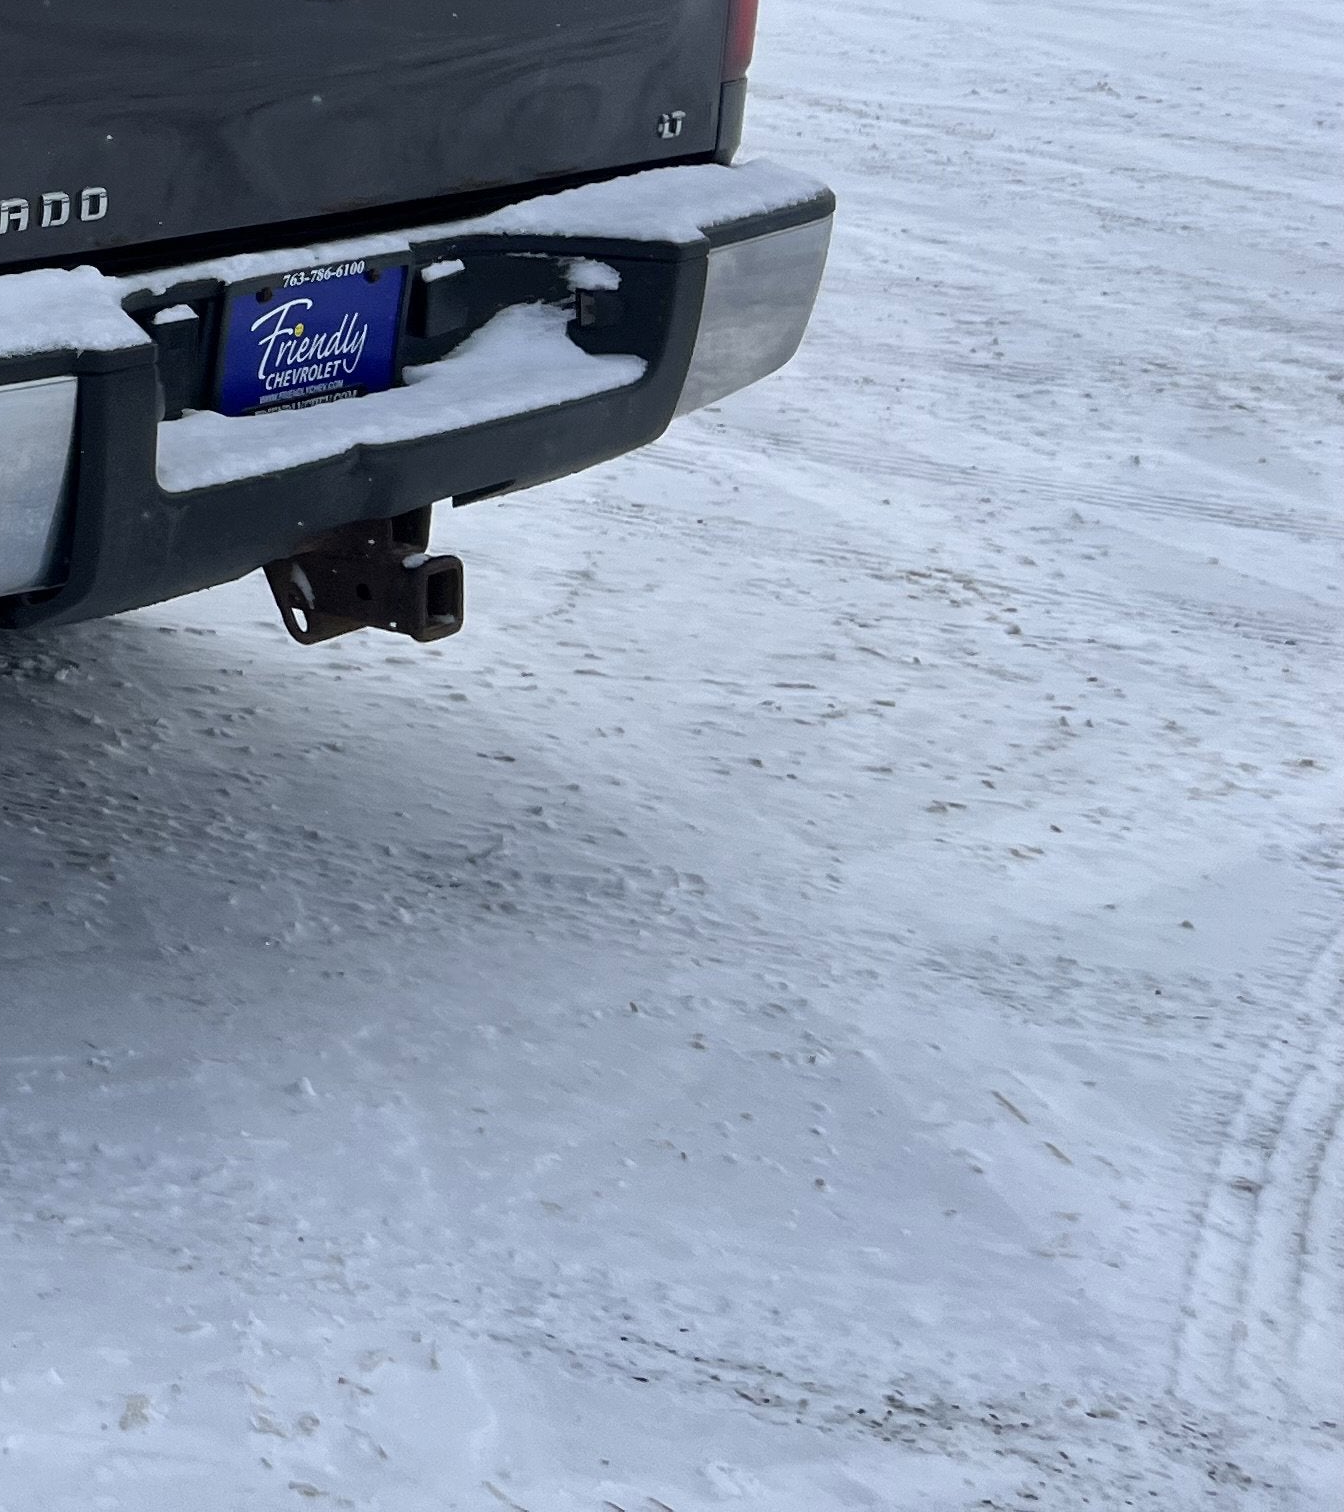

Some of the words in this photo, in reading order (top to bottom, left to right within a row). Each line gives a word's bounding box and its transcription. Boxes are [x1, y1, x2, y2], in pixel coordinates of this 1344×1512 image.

[282, 260, 366, 289] 763-786-6100
[250, 297, 369, 380] Friendly
[265, 359, 342, 391] CHEVROLET
